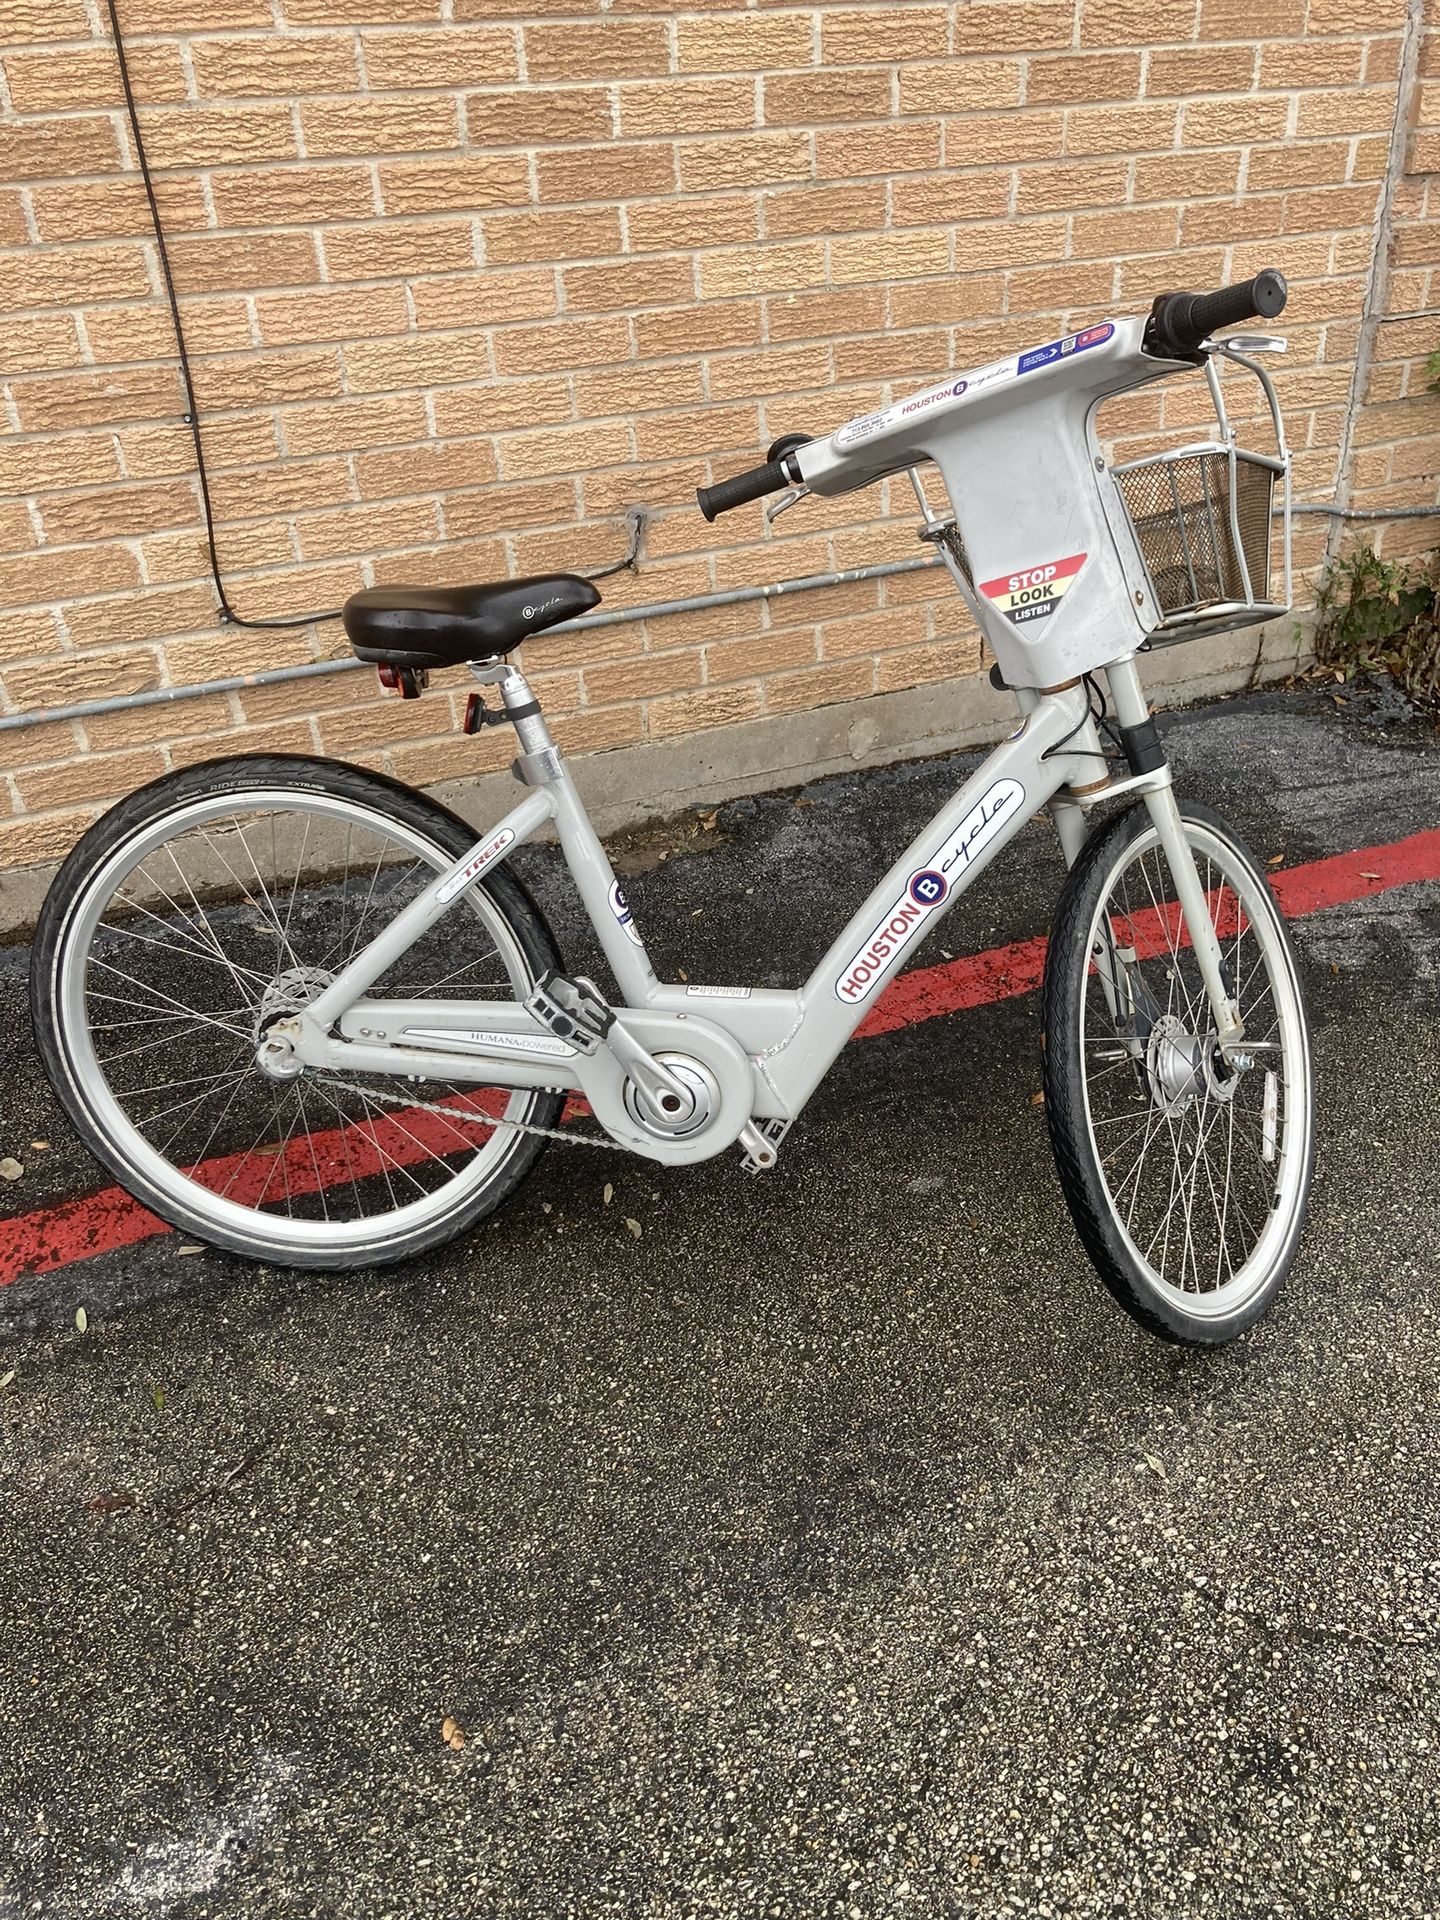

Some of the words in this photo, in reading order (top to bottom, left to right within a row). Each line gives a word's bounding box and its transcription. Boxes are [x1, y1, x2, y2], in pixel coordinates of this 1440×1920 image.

[902, 388, 952, 415] HOUSTON
[1008, 565, 1057, 592] STOP
[1010, 583, 1055, 607] LOOK
[1014, 603, 1051, 620] LISTEN
[461, 835, 507, 877] TREK
[841, 902, 921, 998] HOUSTON
[917, 878, 940, 900] B
